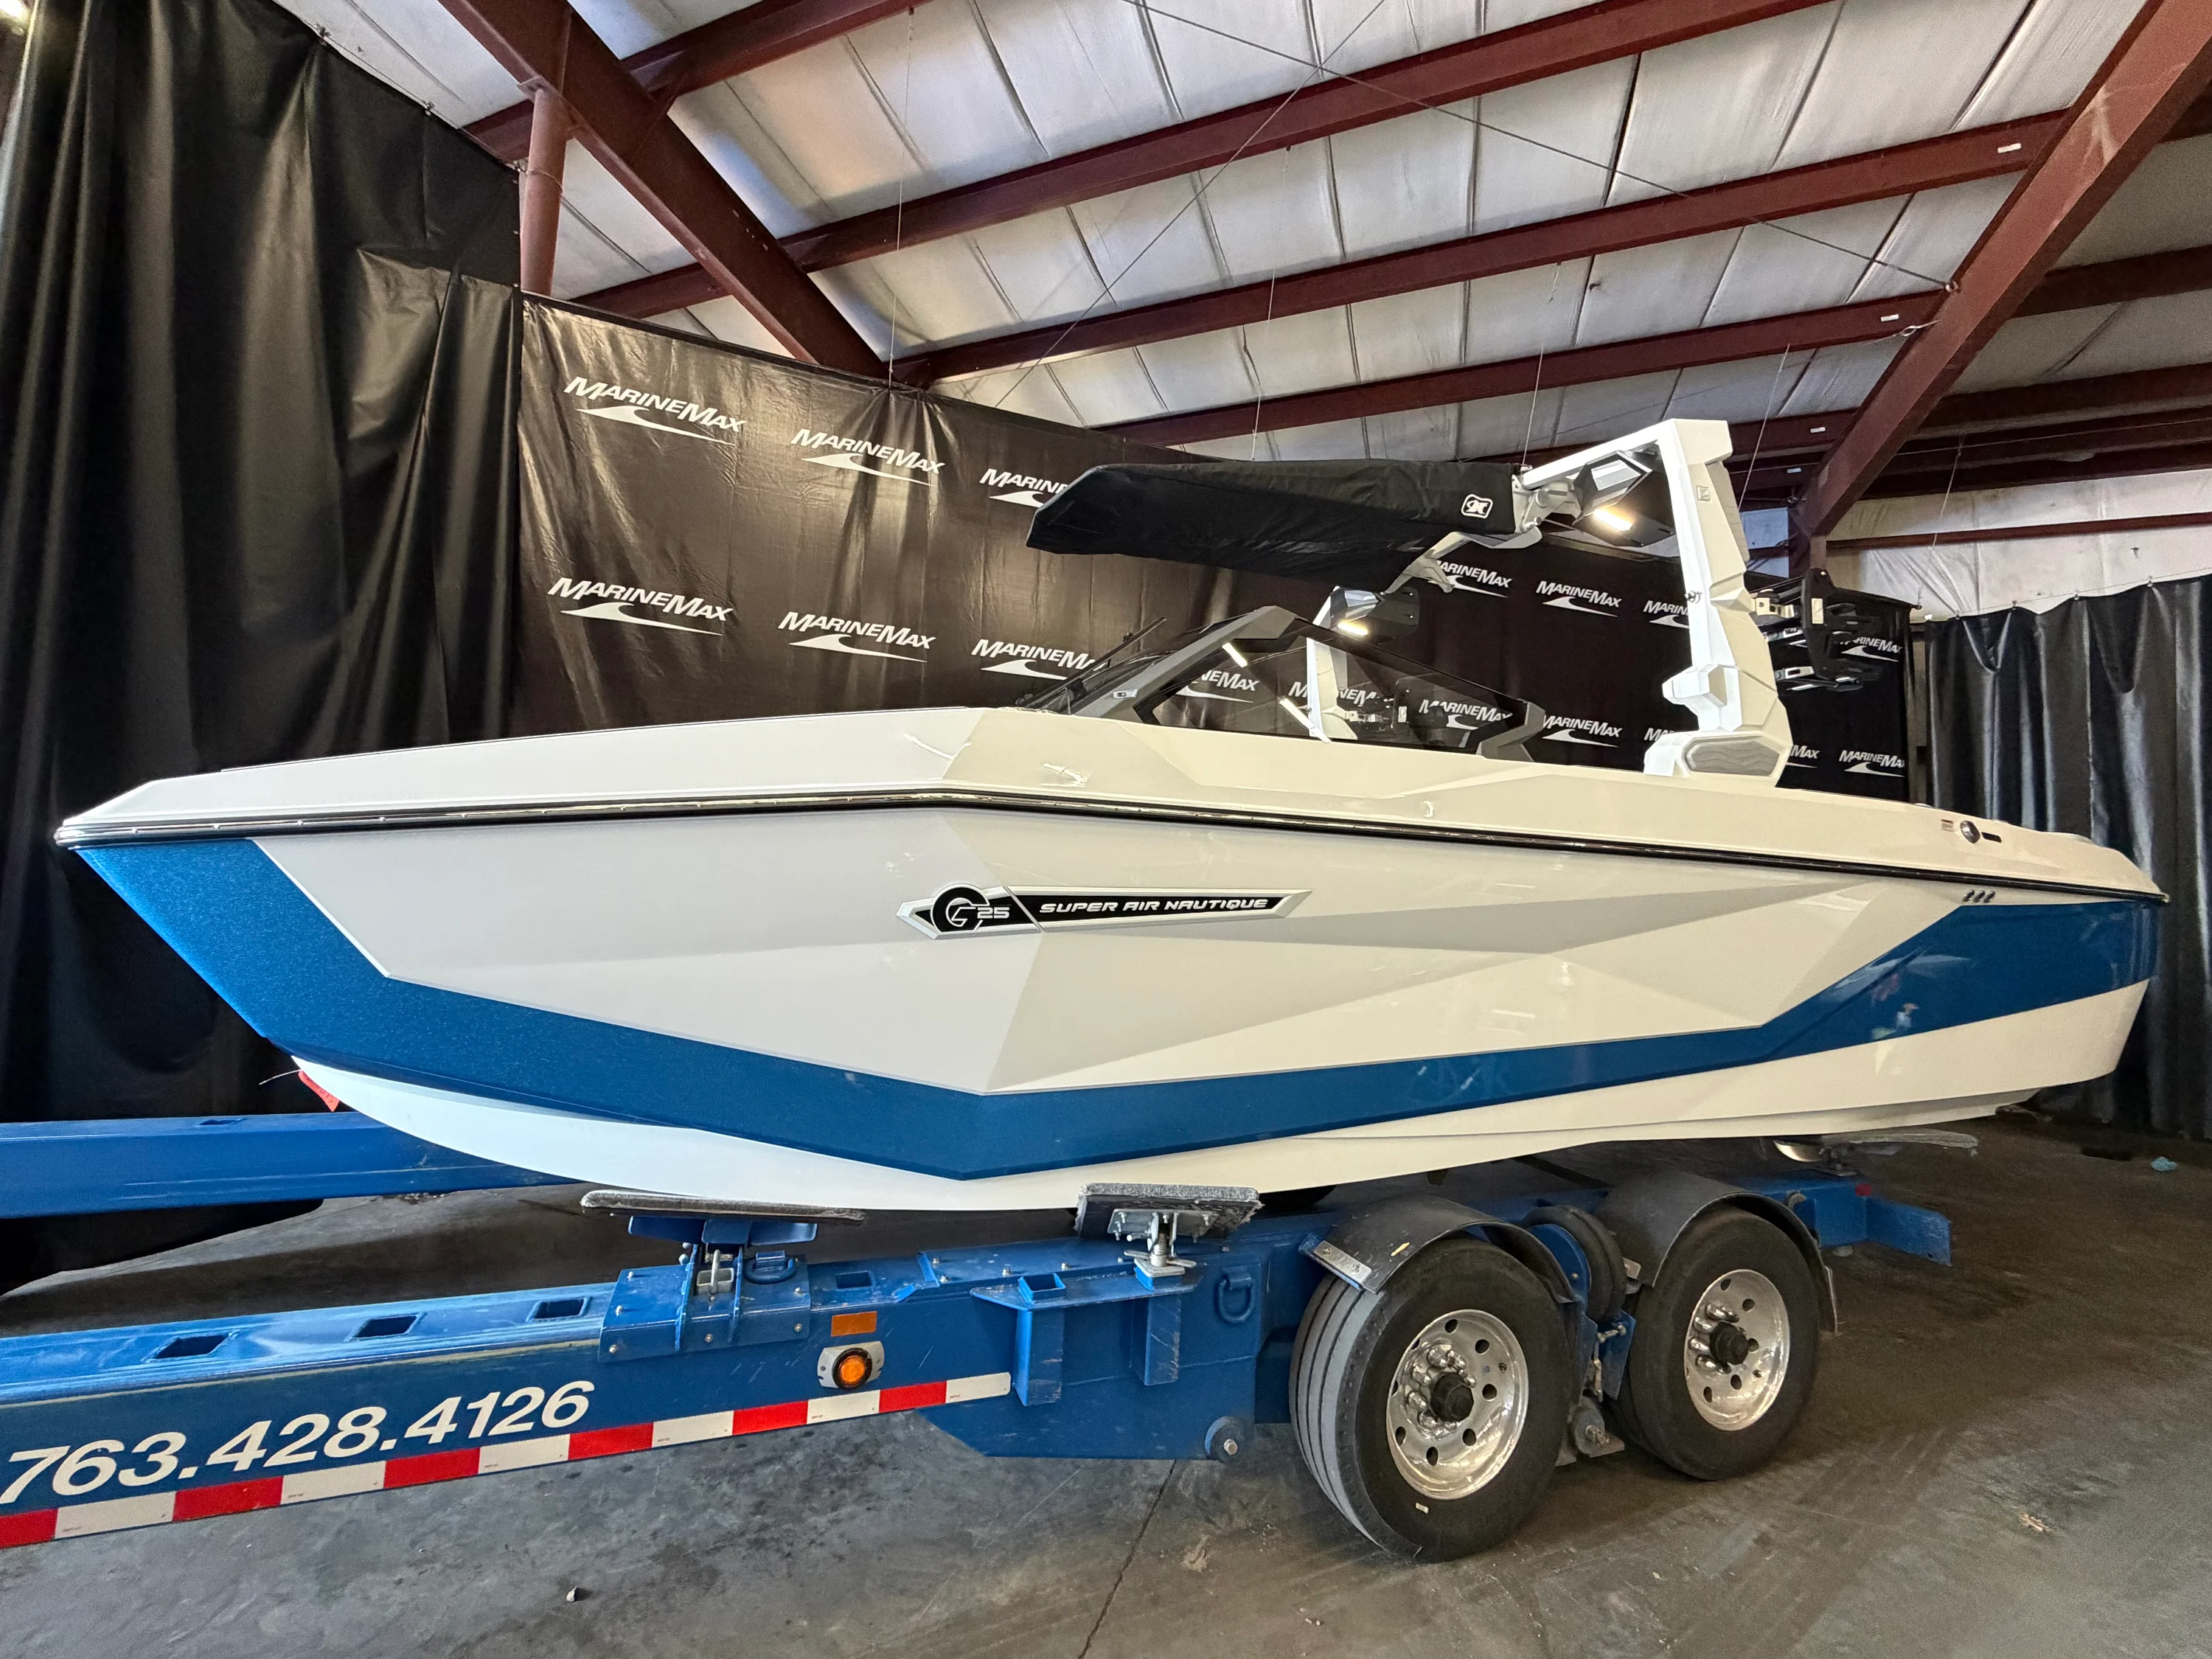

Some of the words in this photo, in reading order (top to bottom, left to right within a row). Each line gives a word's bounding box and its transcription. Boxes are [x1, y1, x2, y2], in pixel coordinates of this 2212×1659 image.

[1039, 901, 1119, 914] SUPER
[1121, 900, 1161, 911] AIR
[1164, 898, 1269, 911] NAUTIQUE
[0, 1380, 595, 1504] 763.428.4126
